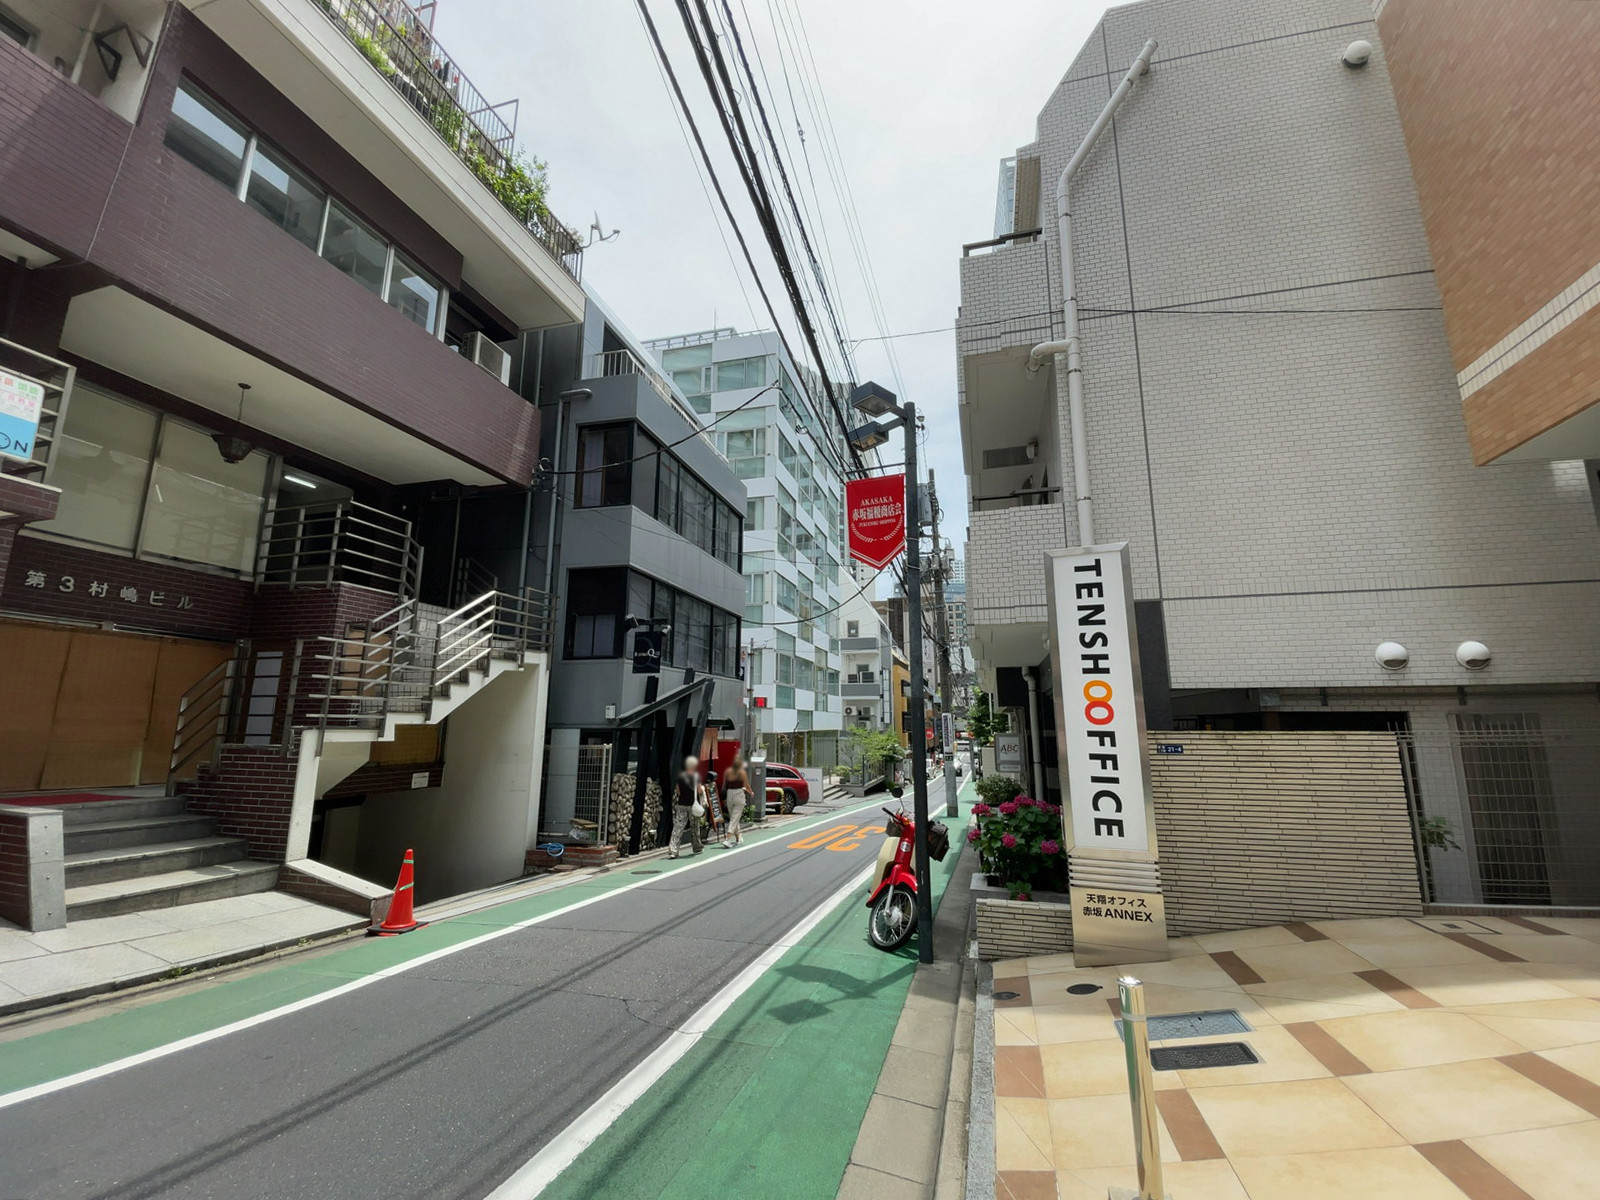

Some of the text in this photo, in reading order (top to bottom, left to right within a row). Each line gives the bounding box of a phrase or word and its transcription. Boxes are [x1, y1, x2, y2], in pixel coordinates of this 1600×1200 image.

[861, 496, 893, 506] AKASAKA
[1000, 744, 1019, 753] ABC
[1086, 893, 1147, 908] 天翔オフィス
[1082, 906, 1154, 923] 赤坂 ANNEX
